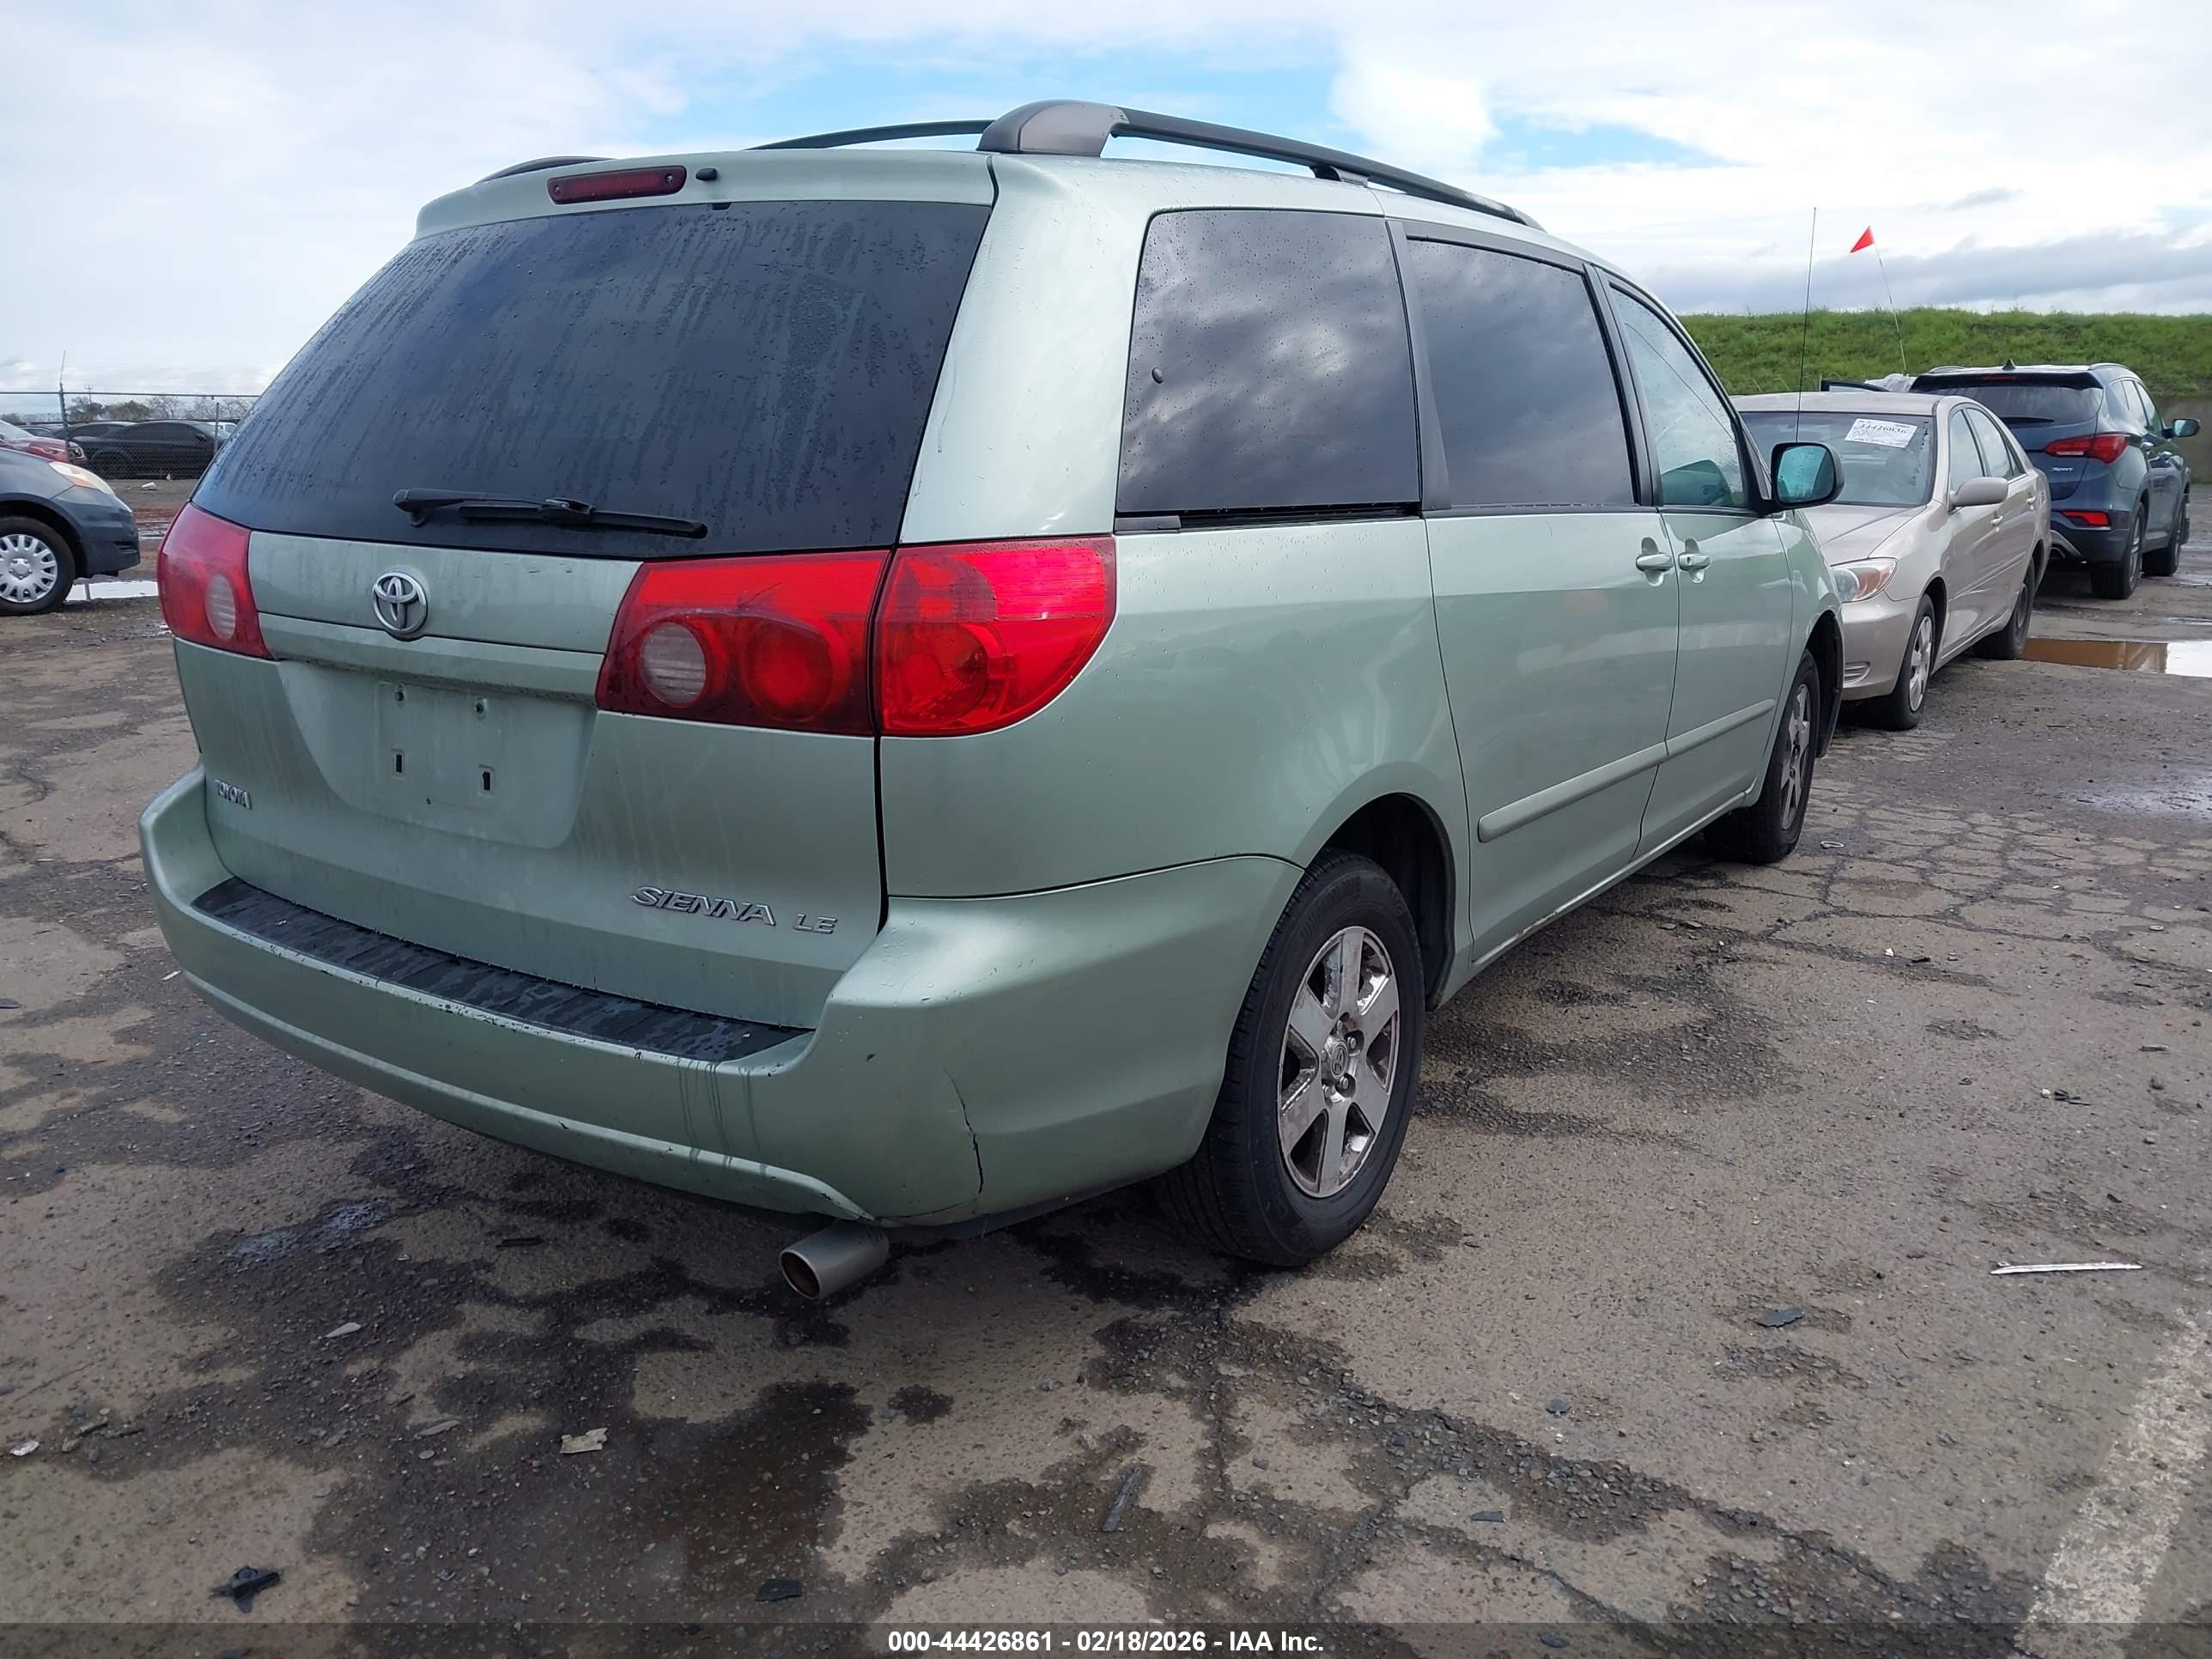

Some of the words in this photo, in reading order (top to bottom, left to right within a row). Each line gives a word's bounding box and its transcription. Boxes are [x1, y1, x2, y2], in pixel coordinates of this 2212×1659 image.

[215, 779, 252, 810] TOYOTA
[629, 886, 776, 926] SIENNA
[793, 913, 838, 934] LE
